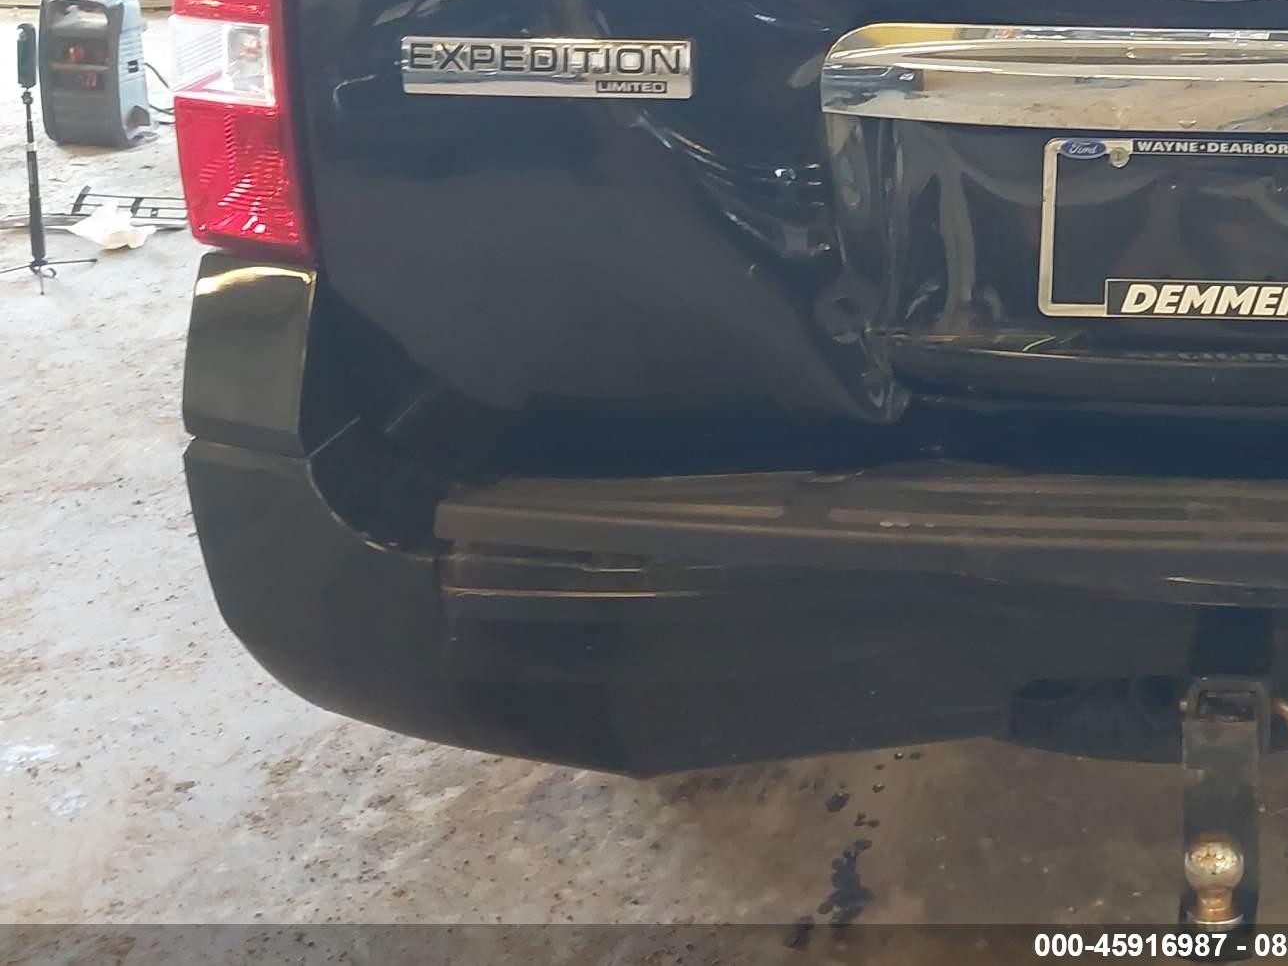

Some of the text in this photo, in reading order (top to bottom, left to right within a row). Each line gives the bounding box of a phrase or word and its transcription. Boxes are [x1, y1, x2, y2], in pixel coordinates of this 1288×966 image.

[409, 42, 682, 74] EXPEDITION
[598, 81, 665, 92] LIMITED
[1068, 141, 1099, 155] Ford
